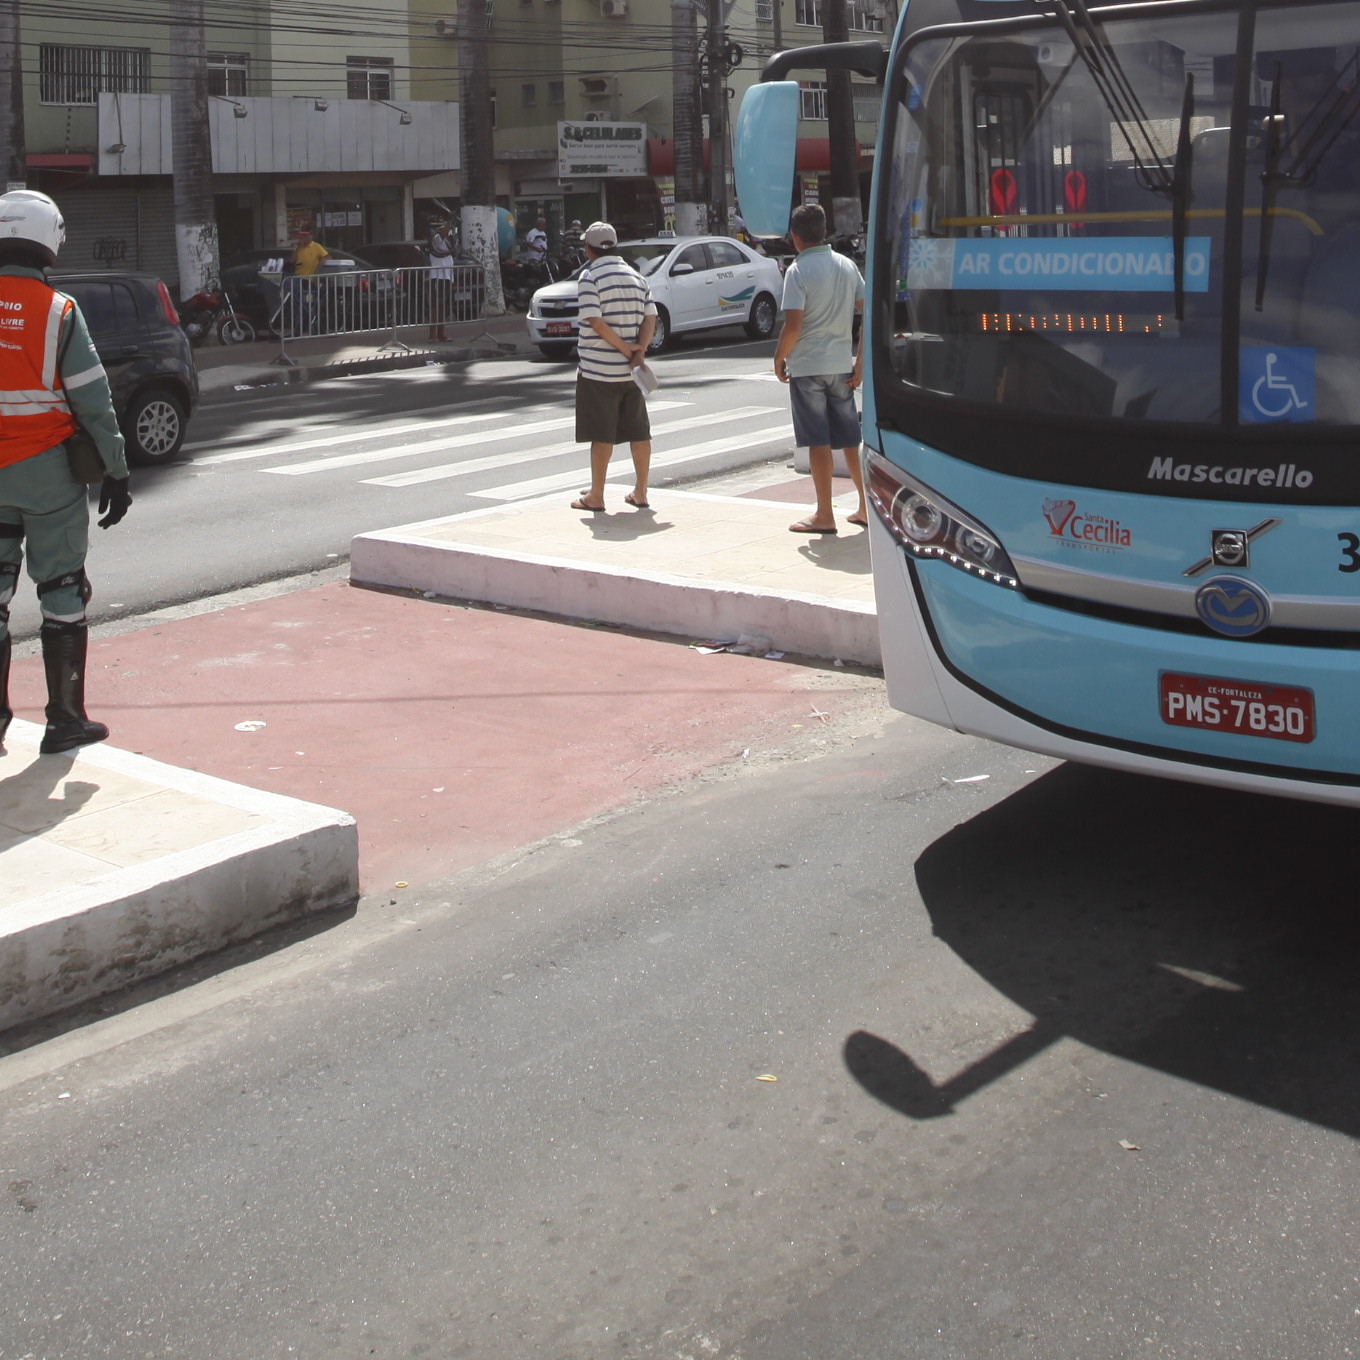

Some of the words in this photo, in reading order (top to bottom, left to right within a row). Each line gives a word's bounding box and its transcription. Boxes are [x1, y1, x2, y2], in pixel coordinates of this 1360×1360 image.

[957, 252, 990, 275] AR
[997, 251, 1206, 277] CONDICIONADO
[0, 317, 24, 326] LIVRE
[1146, 456, 1314, 489] Mascarello
[1083, 511, 1105, 524] Santa
[1070, 515, 1132, 547] Cecilia
[1207, 685, 1262, 700] CE-FORTALEZA
